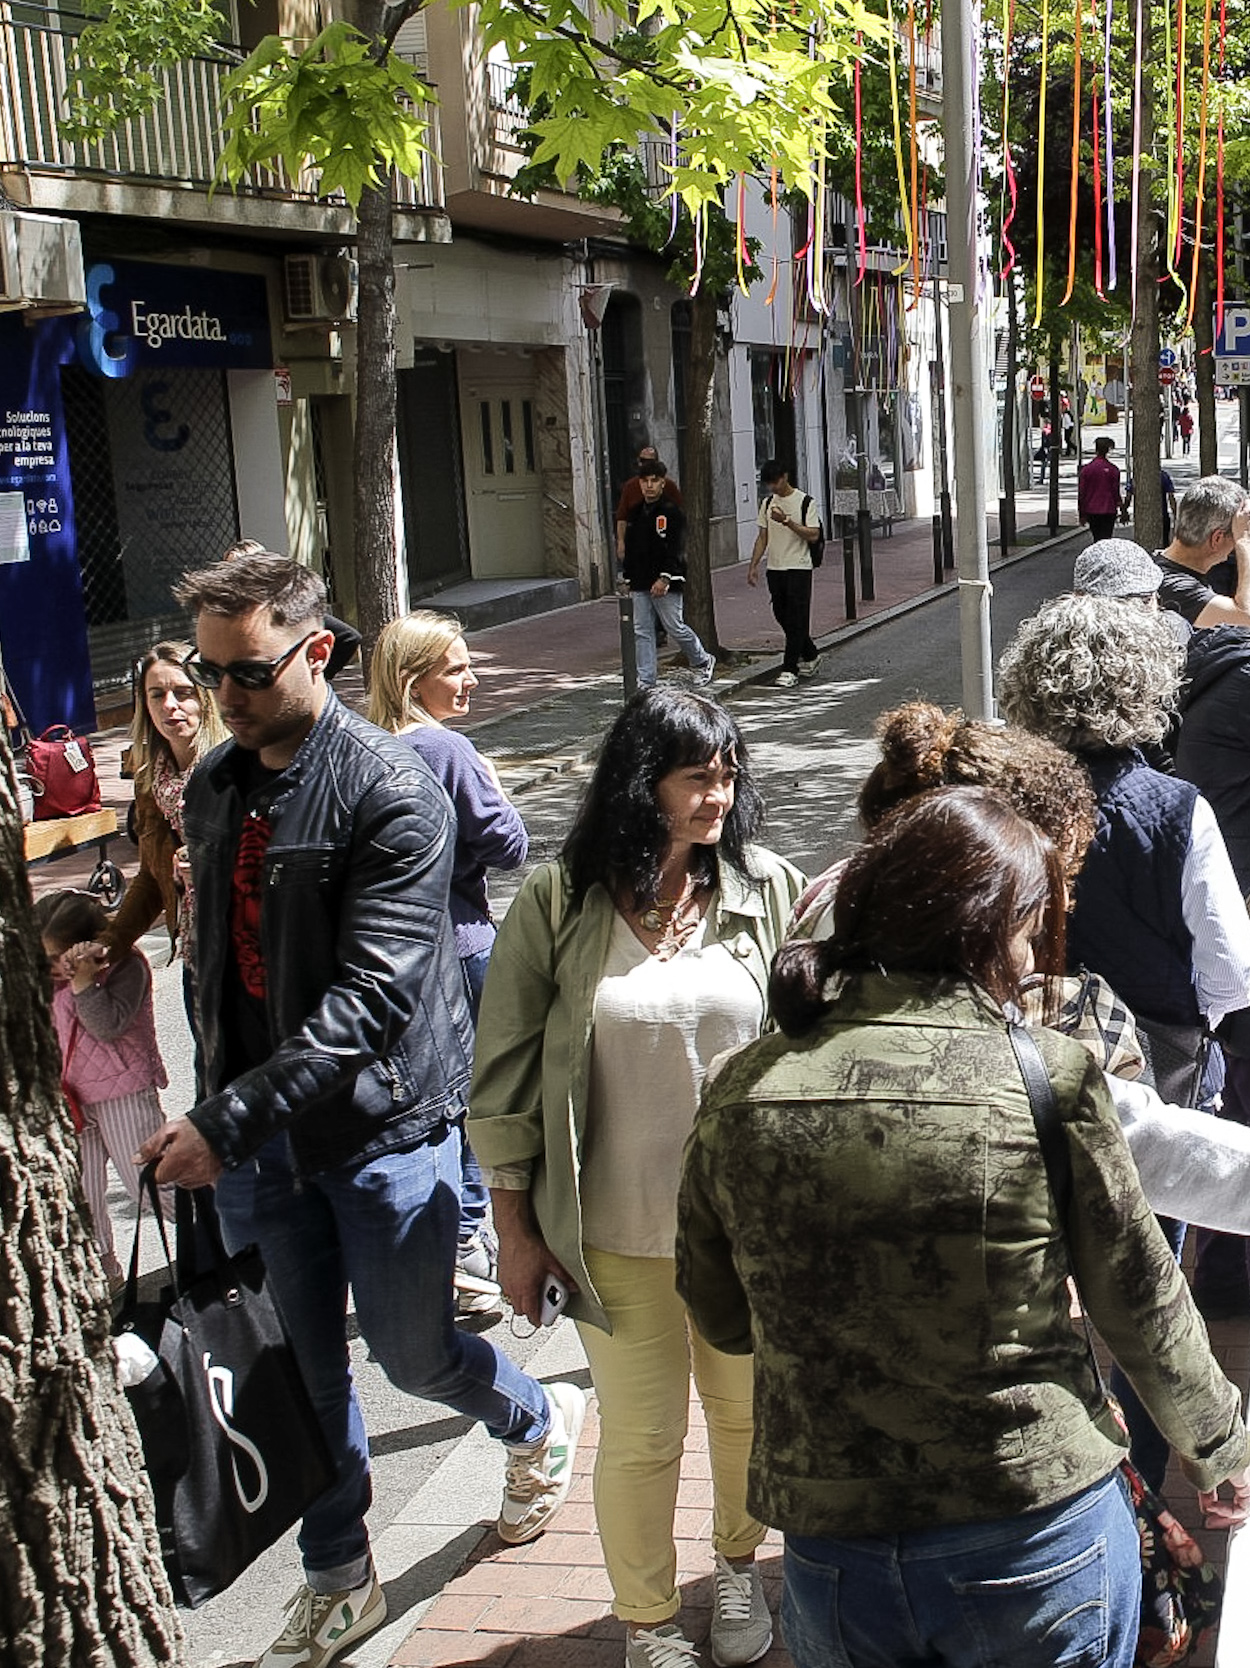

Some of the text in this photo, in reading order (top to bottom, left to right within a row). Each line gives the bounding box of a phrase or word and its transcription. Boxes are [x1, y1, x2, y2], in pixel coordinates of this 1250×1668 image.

[6, 410, 51, 423] Solucions
[14, 441, 21, 452] a
[21, 440, 31, 452] la
[33, 440, 53, 452] teva
[14, 455, 55, 469] empresa
